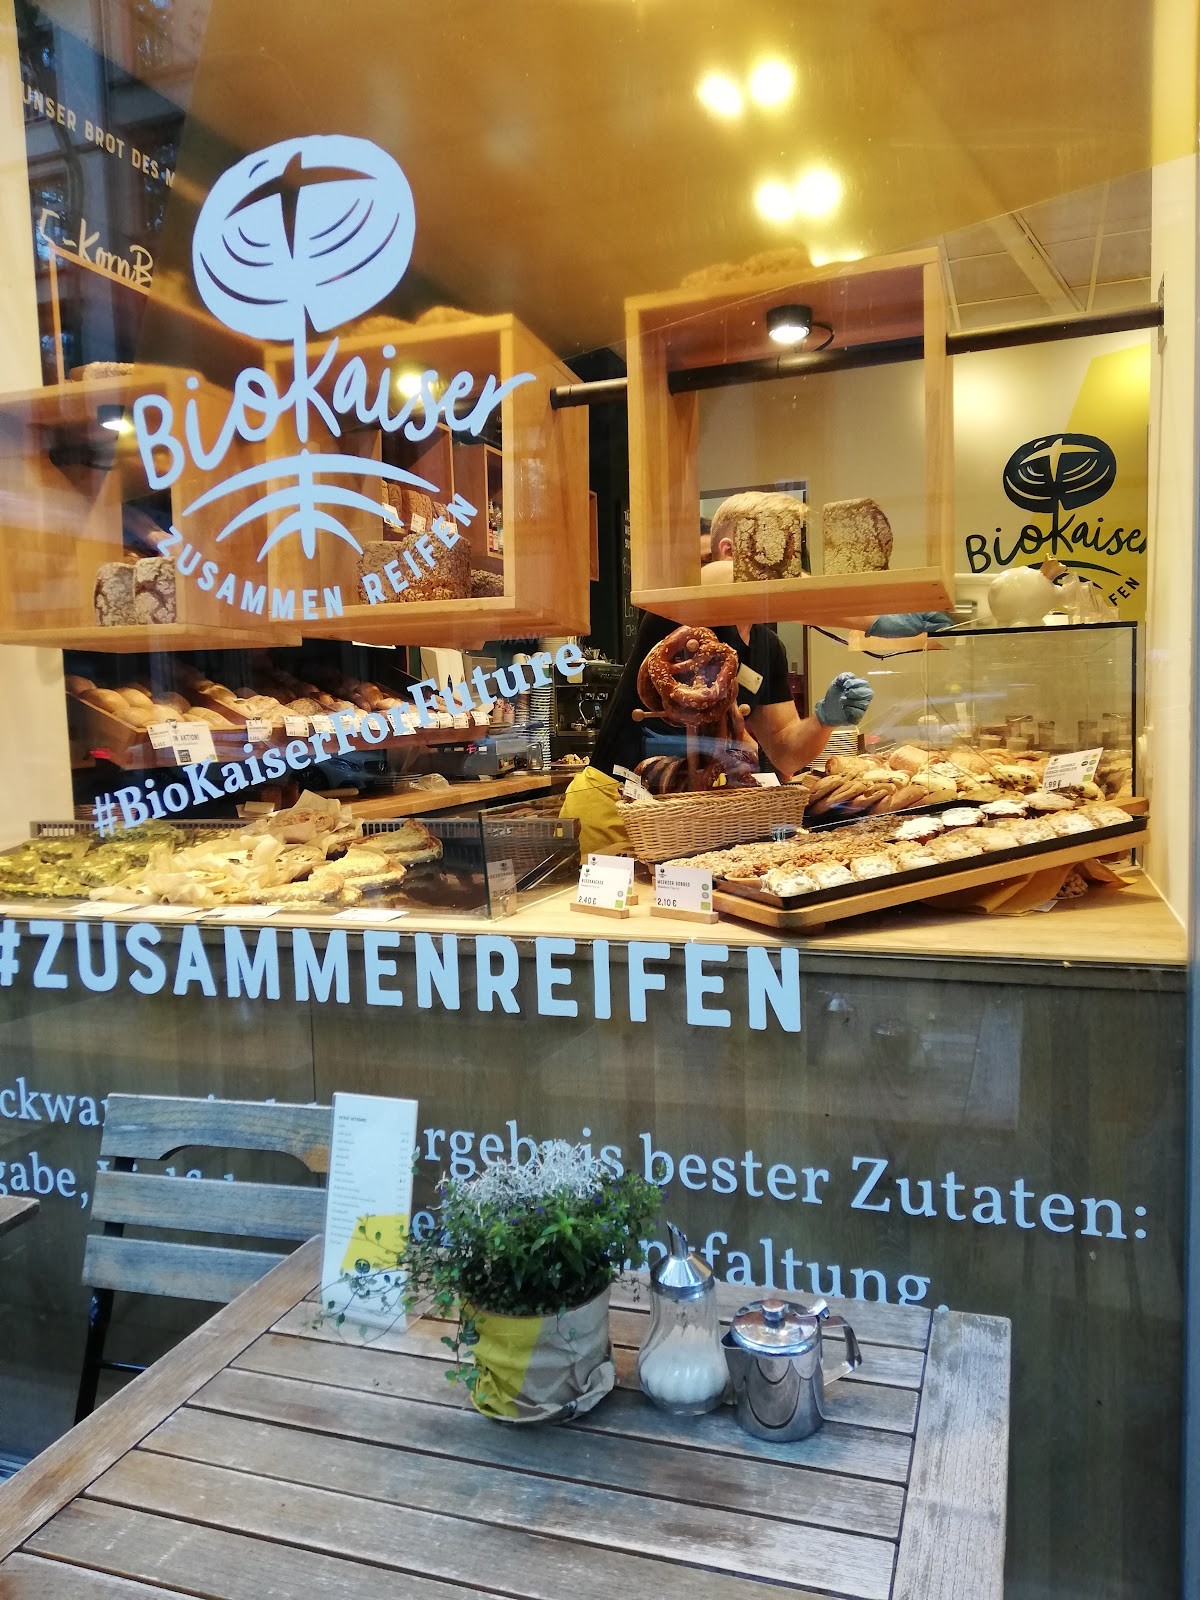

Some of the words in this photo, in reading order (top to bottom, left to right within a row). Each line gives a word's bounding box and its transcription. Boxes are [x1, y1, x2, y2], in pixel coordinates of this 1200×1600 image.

[84, 119, 125, 158] BROT
[132, 148, 159, 179] DES
[132, 336, 536, 490] BioKaiser
[156, 525, 343, 621] ZUSAMMEN
[362, 492, 478, 605] REIFEN
[91, 643, 587, 838] #BioKaiserForFuture
[0, 918, 802, 1033] #ZUSAMMENREIFEN
[639, 1133, 829, 1205] bester
[850, 1156, 1148, 1240] Zutaten:
